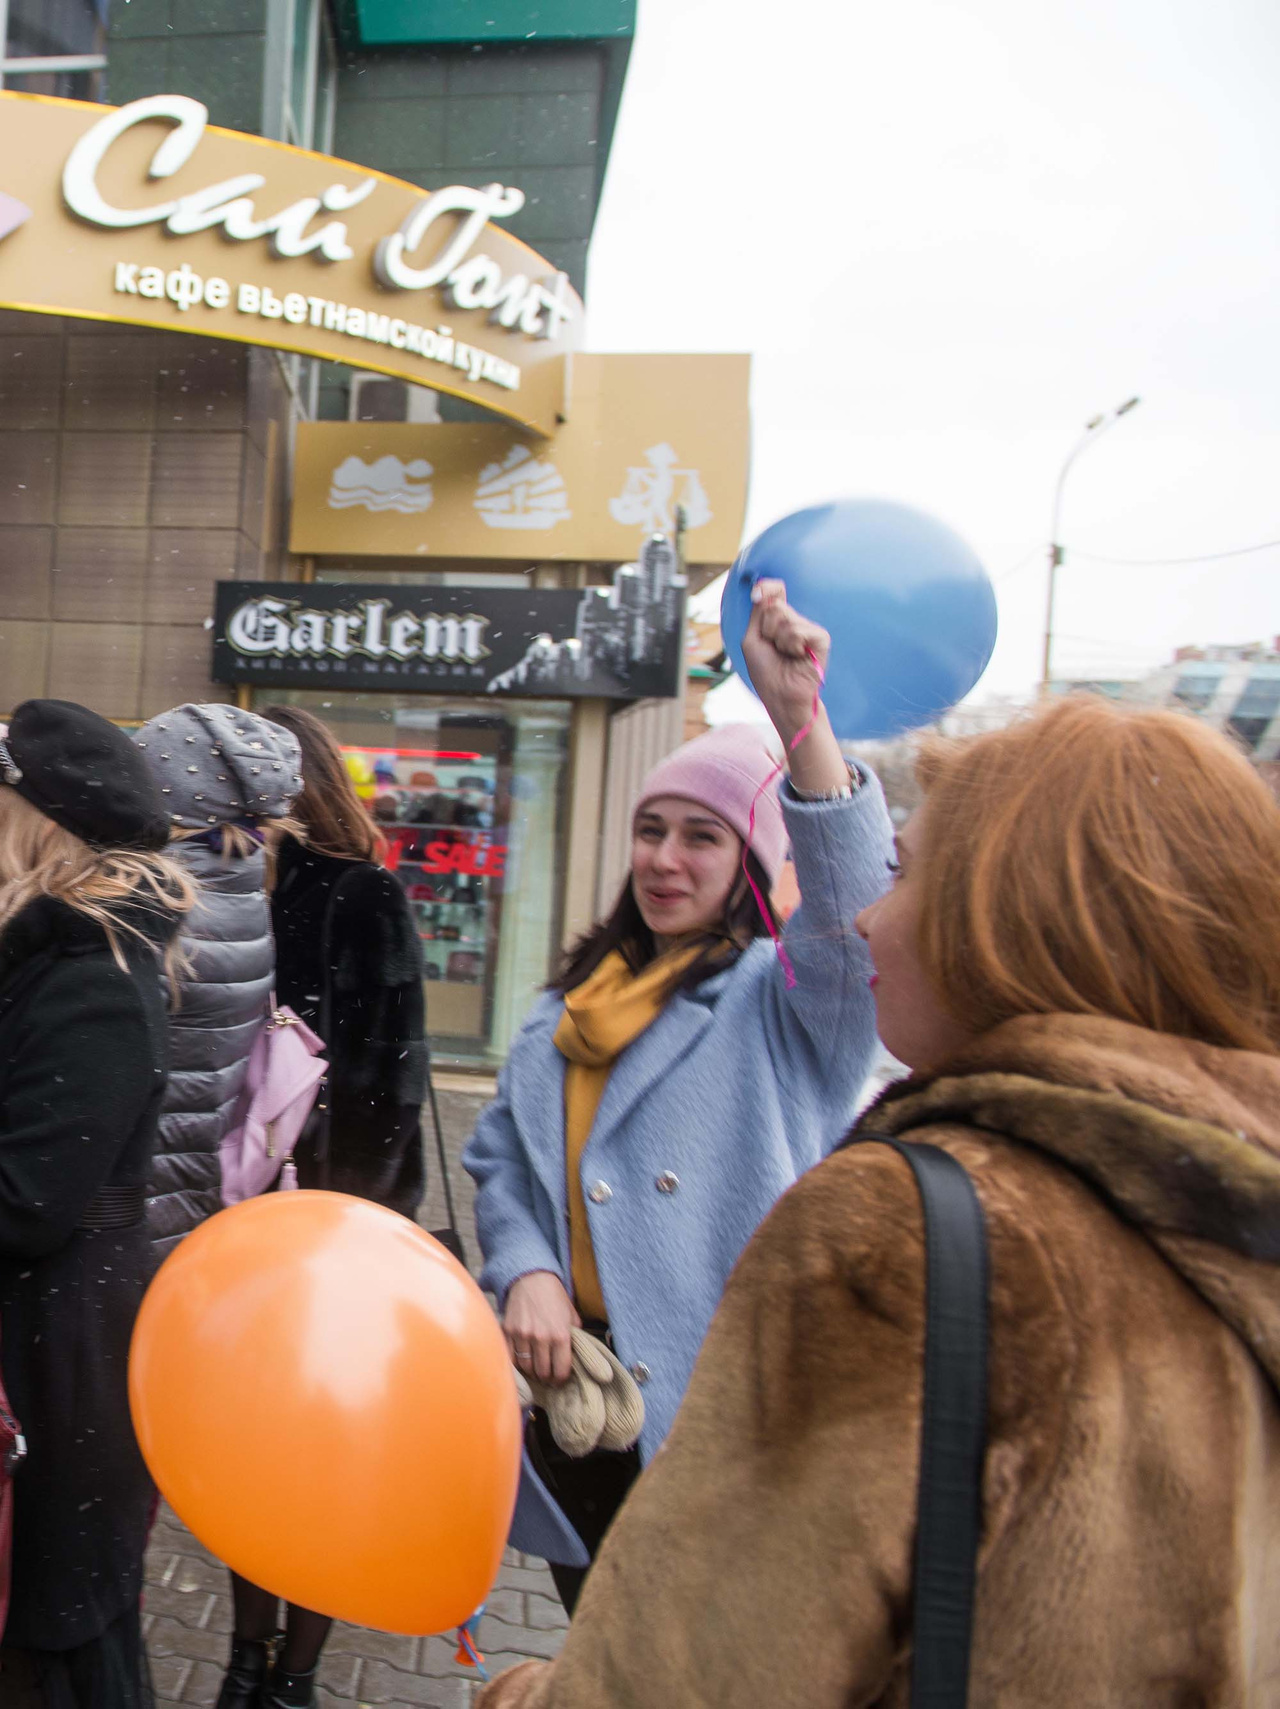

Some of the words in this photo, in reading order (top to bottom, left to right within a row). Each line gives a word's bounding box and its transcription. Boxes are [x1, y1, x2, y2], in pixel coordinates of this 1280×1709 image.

[62, 94, 377, 262] Сай
[114, 262, 230, 311] кафе
[237, 282, 455, 367] вьетнамской
[226, 595, 491, 664] Garlem
[421, 841, 508, 878] SALE
